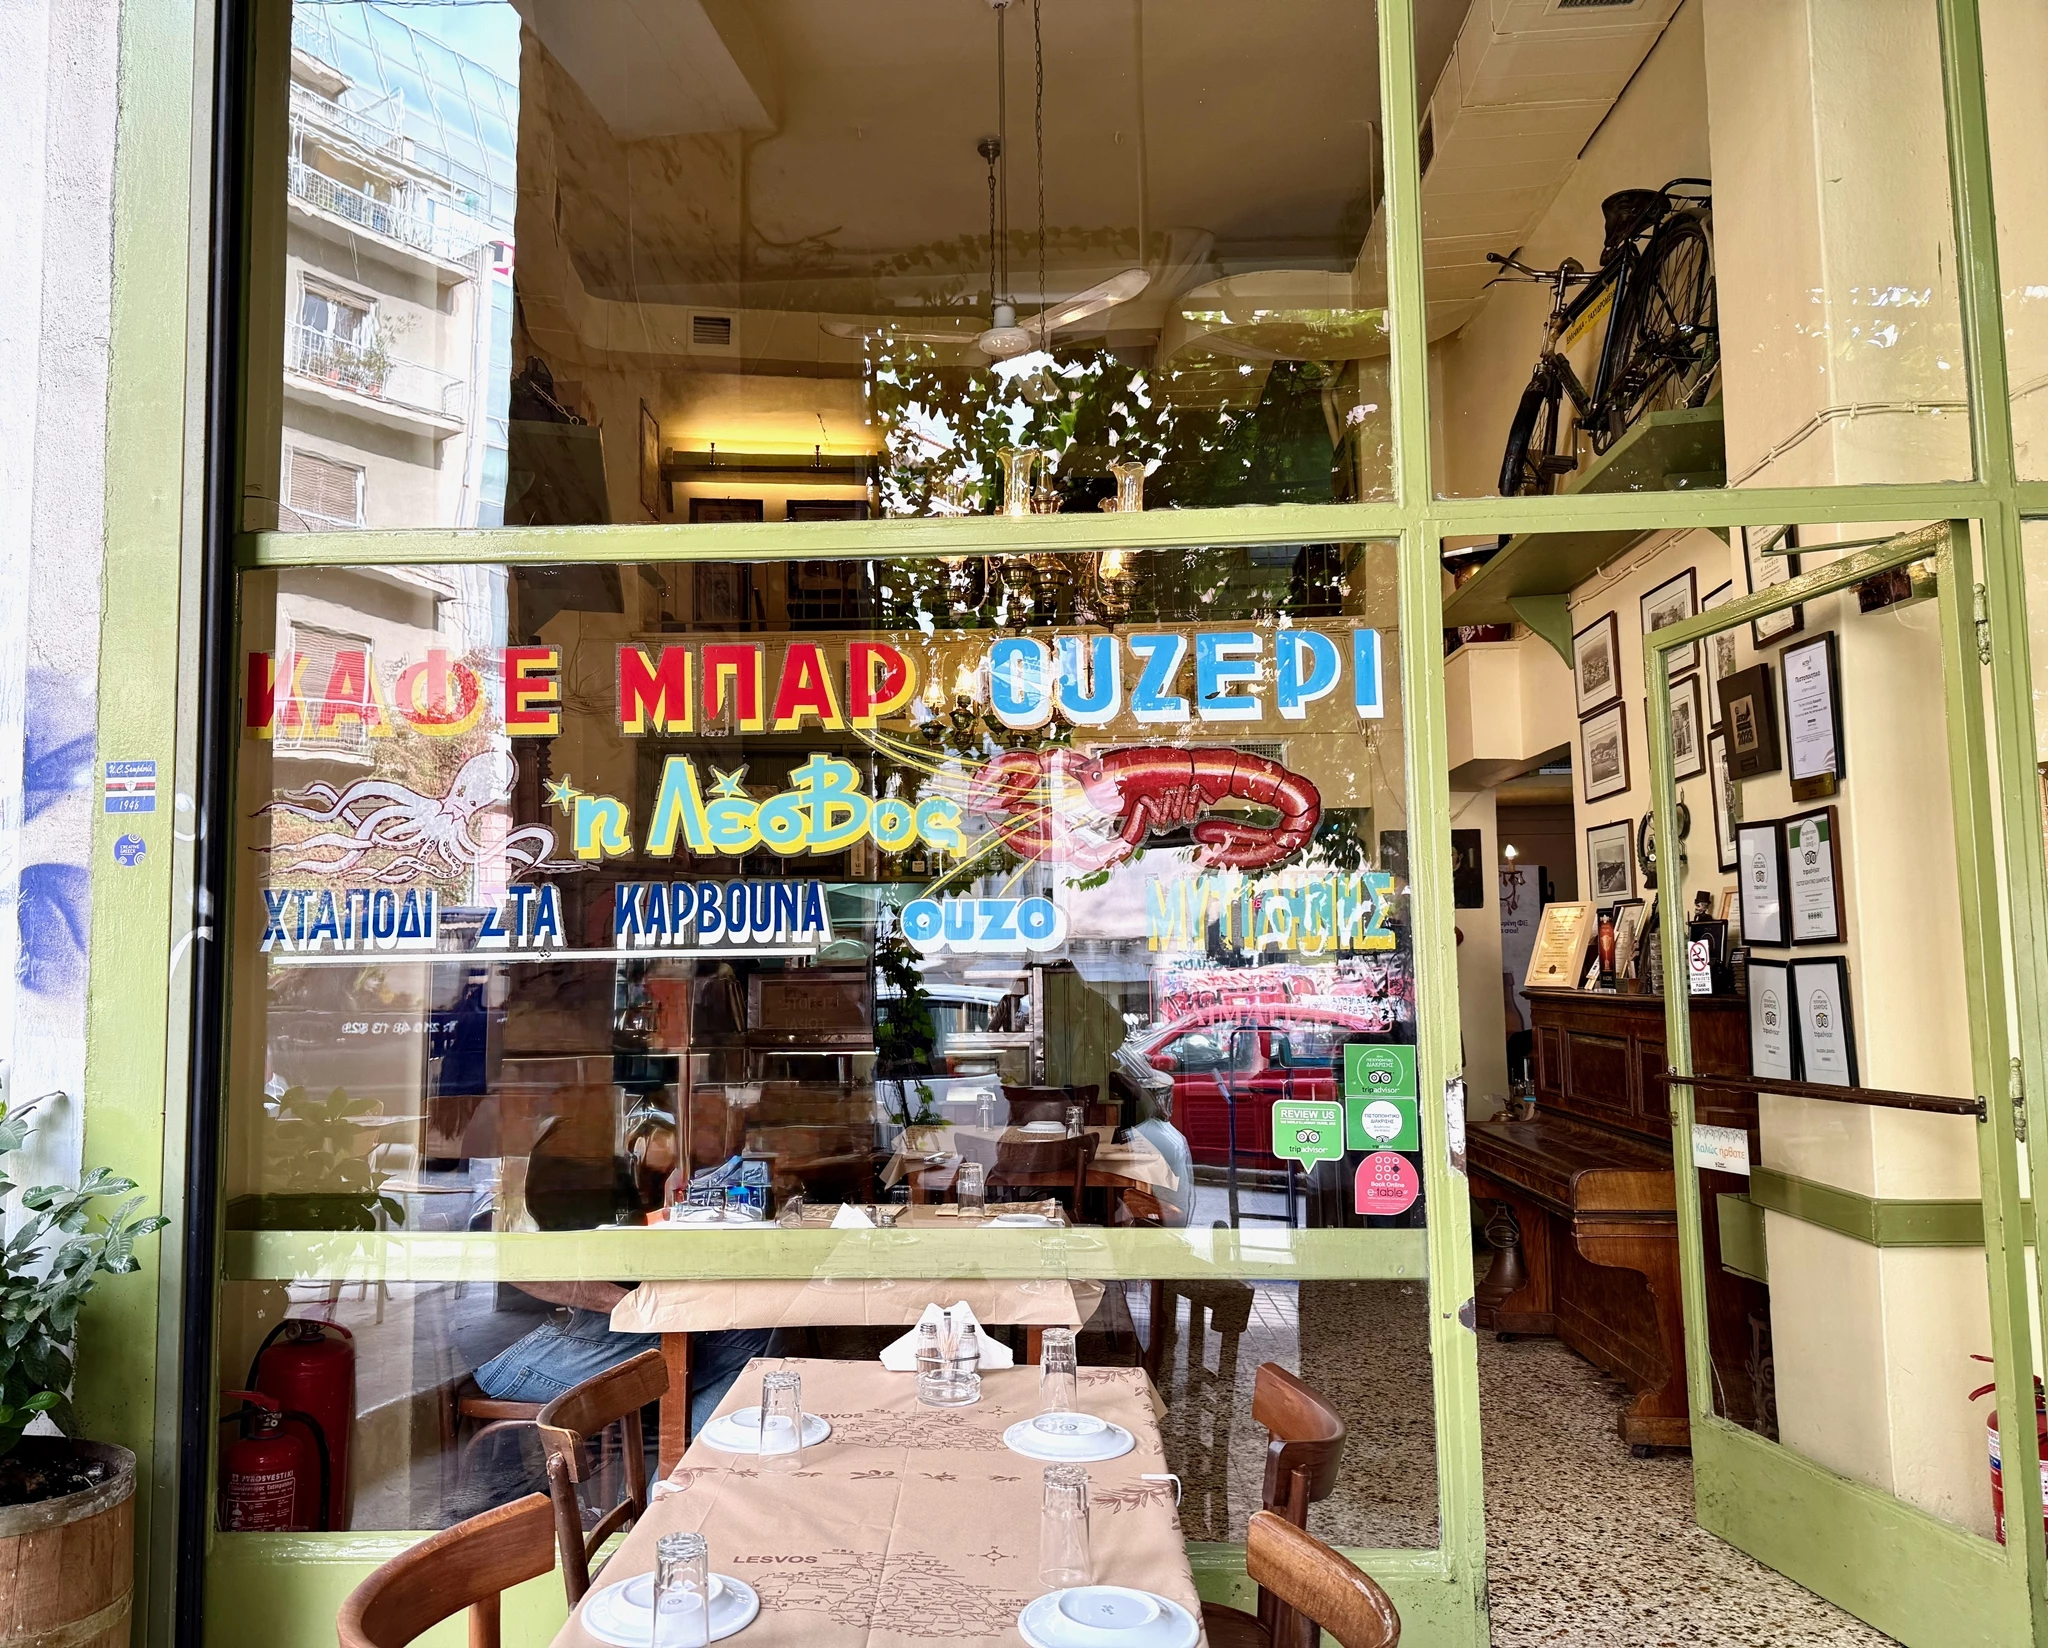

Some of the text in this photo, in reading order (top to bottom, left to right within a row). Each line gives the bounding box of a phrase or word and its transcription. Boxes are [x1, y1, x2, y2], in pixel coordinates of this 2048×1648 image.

[247, 650, 558, 737] ΚΑΦΕ
[618, 643, 918, 733] ΜΠΑΡ
[119, 799, 140, 810] 1946
[260, 887, 437, 952] ΧΤΑΠΟΔΙ
[477, 883, 564, 948] ΣΤΑ
[1362, 1086, 1400, 1094] tripadvisor
[1281, 1109, 1335, 1119] REVIEW US
[733, 1555, 818, 1564] LESVOS
